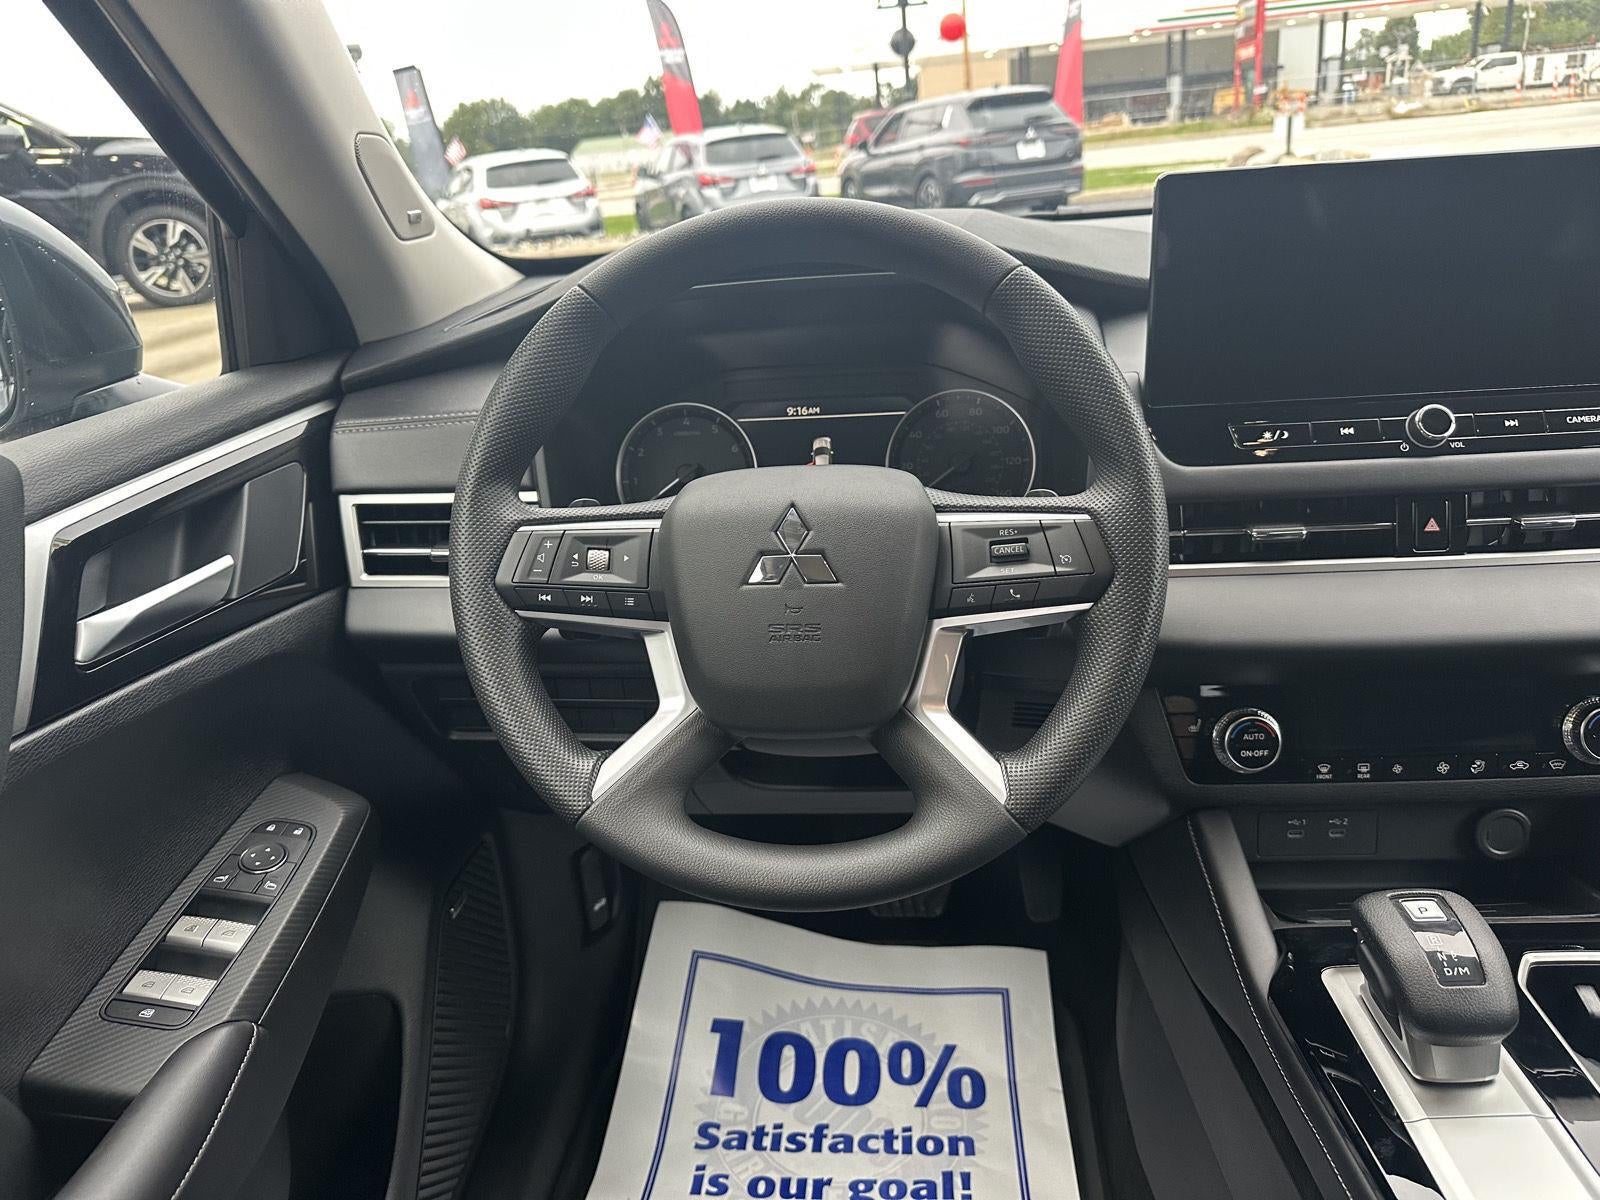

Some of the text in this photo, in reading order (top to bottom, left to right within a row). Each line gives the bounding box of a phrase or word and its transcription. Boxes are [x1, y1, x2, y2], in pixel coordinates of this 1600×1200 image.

[935, 409, 949, 418] 60
[968, 407, 983, 416] 80
[683, 417, 690, 426] 4
[656, 427, 663, 436] 3
[712, 425, 719, 434] 5
[992, 425, 1010, 434] 100
[994, 545, 1025, 555] CANCEL
[767, 623, 822, 633] SRS
[768, 634, 822, 642] AIRBAG
[1243, 733, 1265, 741] AUTO
[1418, 906, 1428, 915] P
[1437, 952, 1448, 961] N
[1443, 966, 1470, 976] D/M
[709, 1017, 986, 1110] 100%
[694, 1121, 976, 1156] Satisfaction
[689, 1164, 972, 1200] is our goal!
